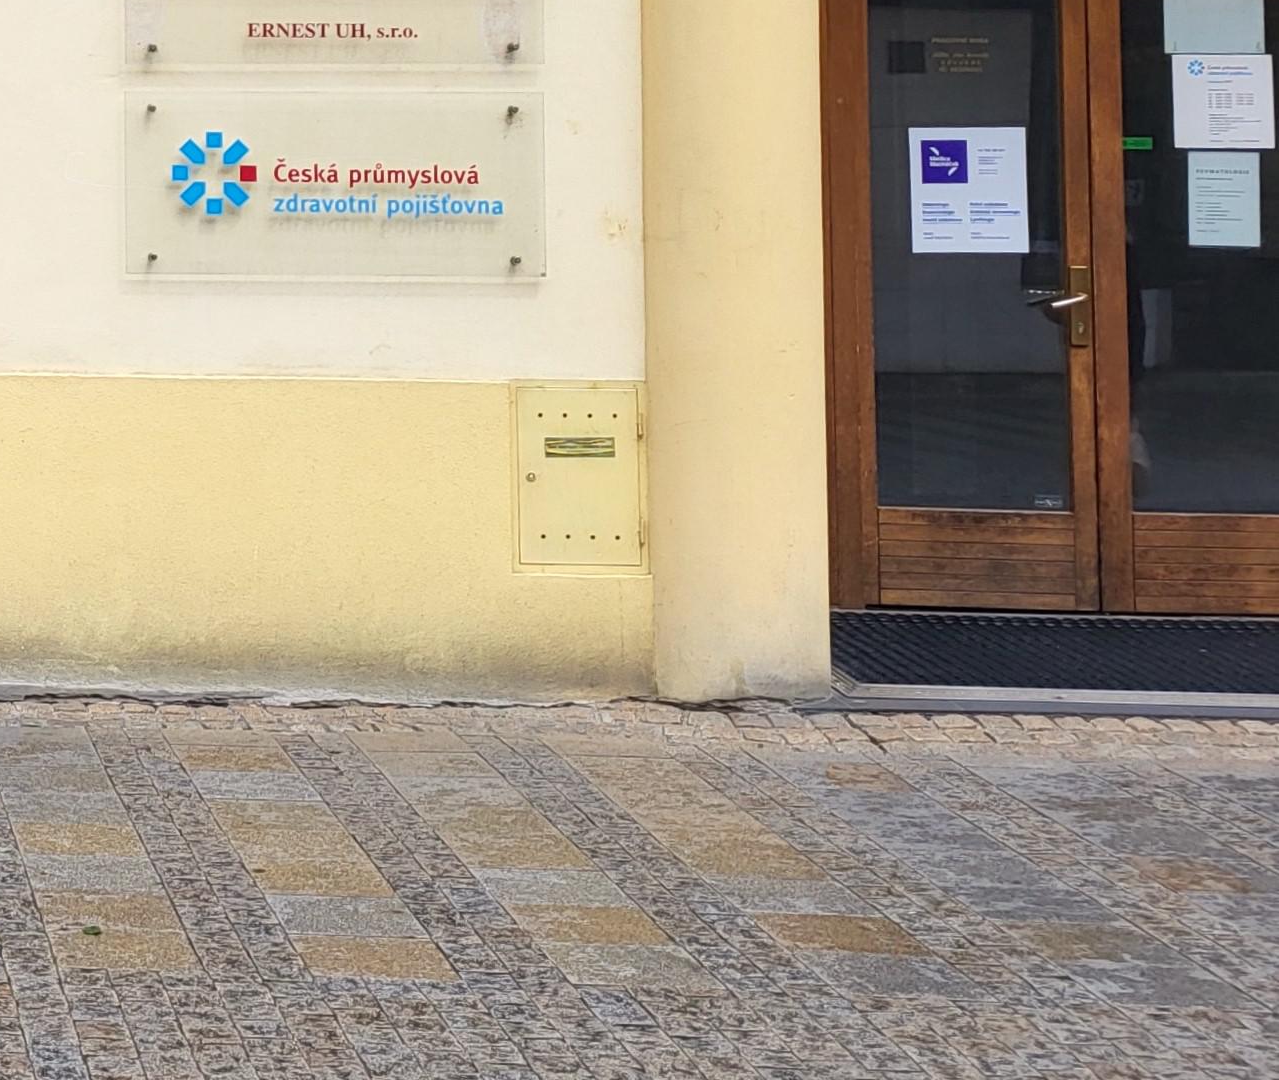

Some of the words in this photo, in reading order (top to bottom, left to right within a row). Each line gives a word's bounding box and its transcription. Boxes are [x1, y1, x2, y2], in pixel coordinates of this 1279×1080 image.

[247, 22, 330, 39] ERNEST
[335, 22, 371, 40] UH,
[376, 26, 418, 39] s.r.o.
[274, 158, 339, 183] Česká
[349, 163, 479, 189] průmyslová
[273, 193, 378, 214] zdravotní
[386, 193, 504, 219] pojišťovna
